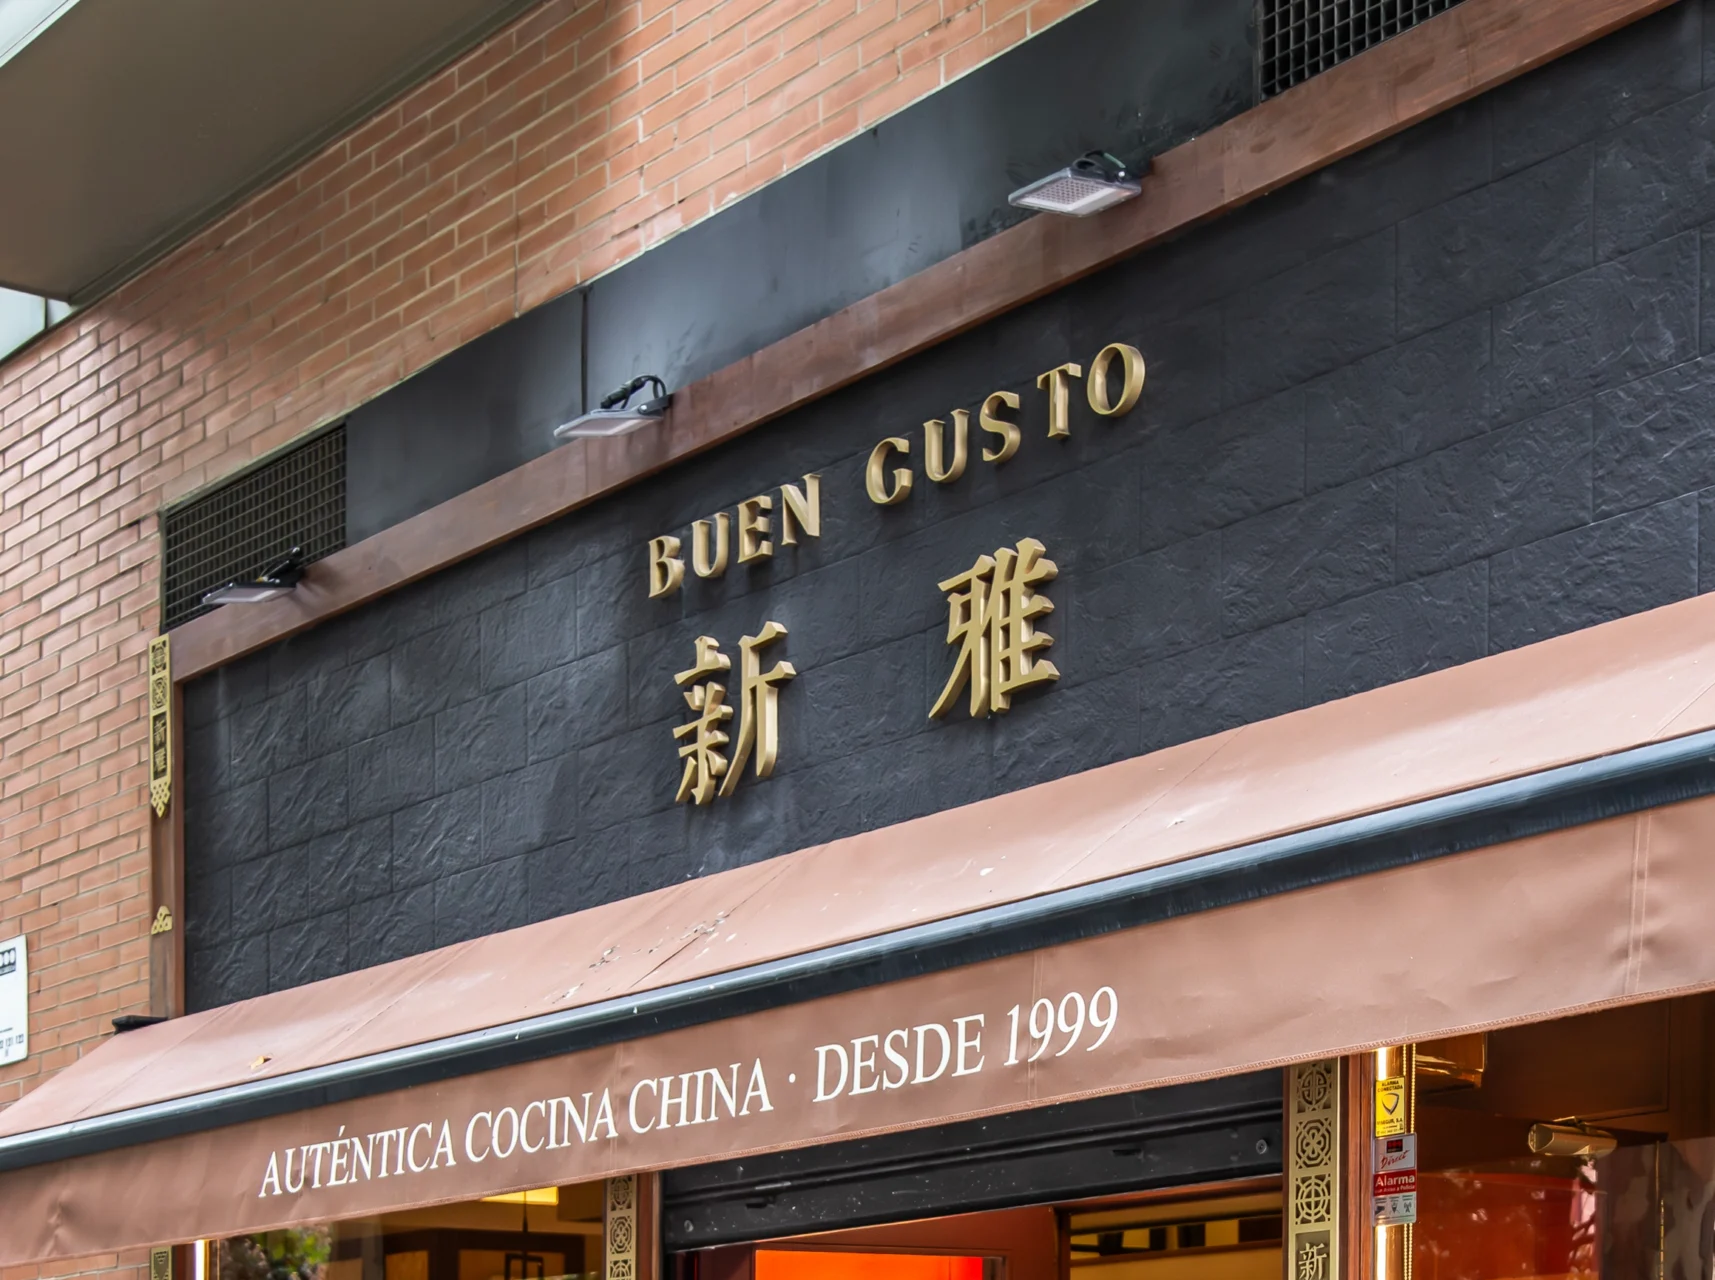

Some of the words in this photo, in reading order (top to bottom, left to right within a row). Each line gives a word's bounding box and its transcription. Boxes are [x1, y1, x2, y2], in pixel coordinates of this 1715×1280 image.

[648, 474, 822, 598] BUEN
[865, 342, 1146, 505] GUSTO
[258, 1125, 457, 1197] AUTÉNTICA
[465, 1087, 618, 1163] COCINA
[628, 1057, 774, 1134] CHINA
[813, 1013, 986, 1103] DESDE
[1003, 985, 1119, 1067] 1999
[1375, 1175, 1415, 1188] Alarma
